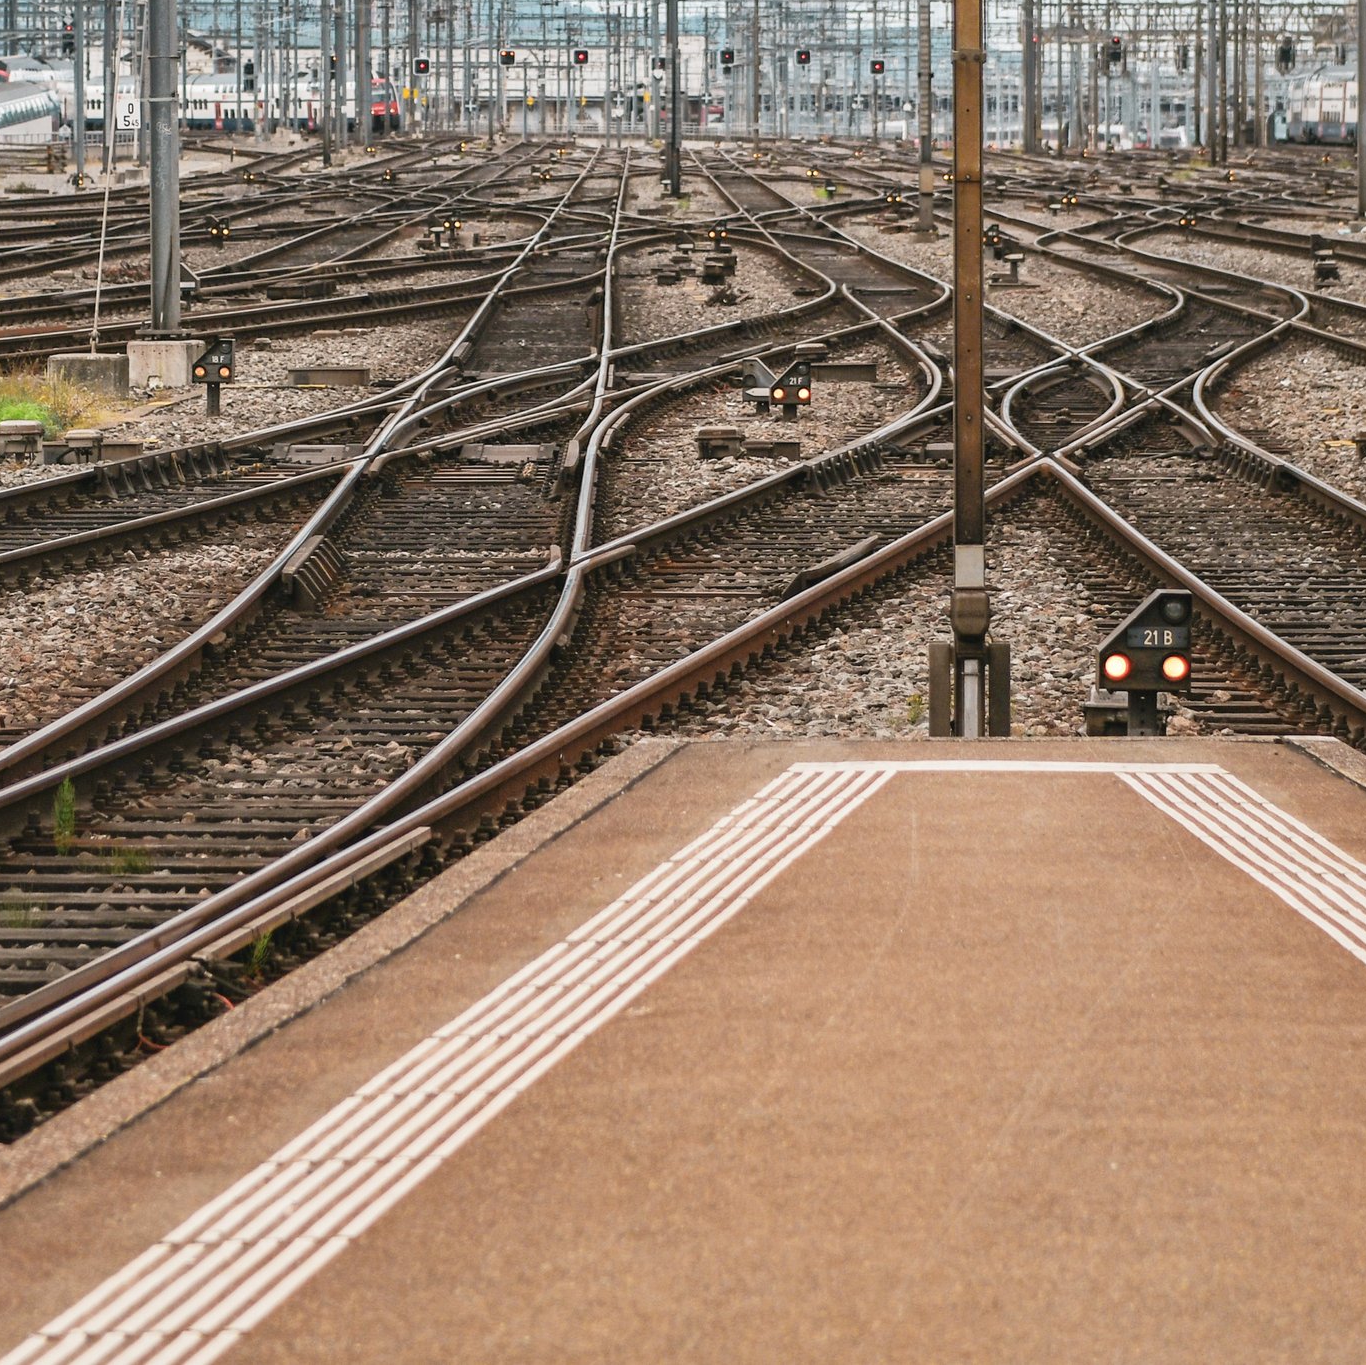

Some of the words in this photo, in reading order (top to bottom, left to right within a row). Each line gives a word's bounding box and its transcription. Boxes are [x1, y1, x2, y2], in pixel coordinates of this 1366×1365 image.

[127, 102, 135, 115] 0
[220, 355, 225, 363] F
[788, 377, 796, 385] 21
[798, 377, 803, 385] F
[1143, 629, 1158, 646] 21
[1164, 630, 1173, 646] B
